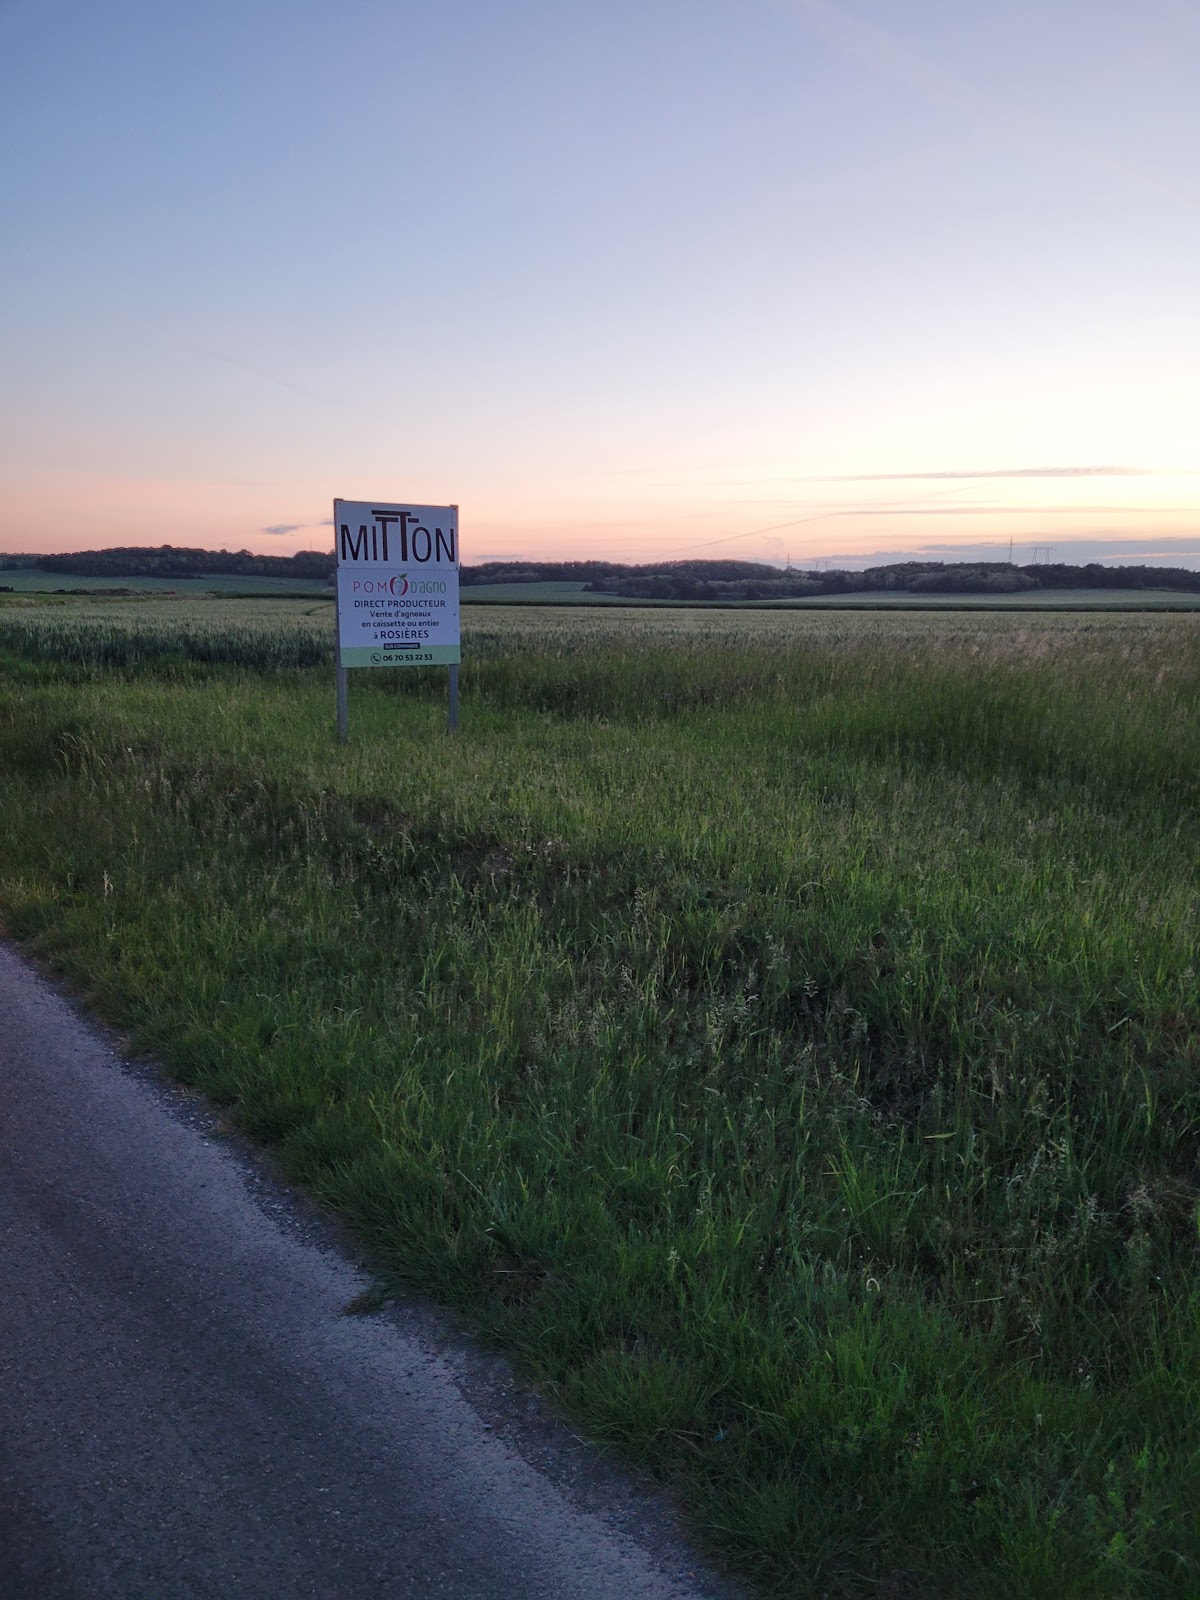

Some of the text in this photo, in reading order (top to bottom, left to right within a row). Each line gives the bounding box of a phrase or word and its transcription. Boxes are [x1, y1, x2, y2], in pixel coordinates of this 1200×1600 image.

[340, 509, 455, 562] MITTON
[354, 600, 446, 608] DIRECT PRODUCTEUR
[394, 610, 431, 619] d'agneaux
[372, 620, 405, 628] caissette
[380, 628, 429, 639] ROSIÈRES
